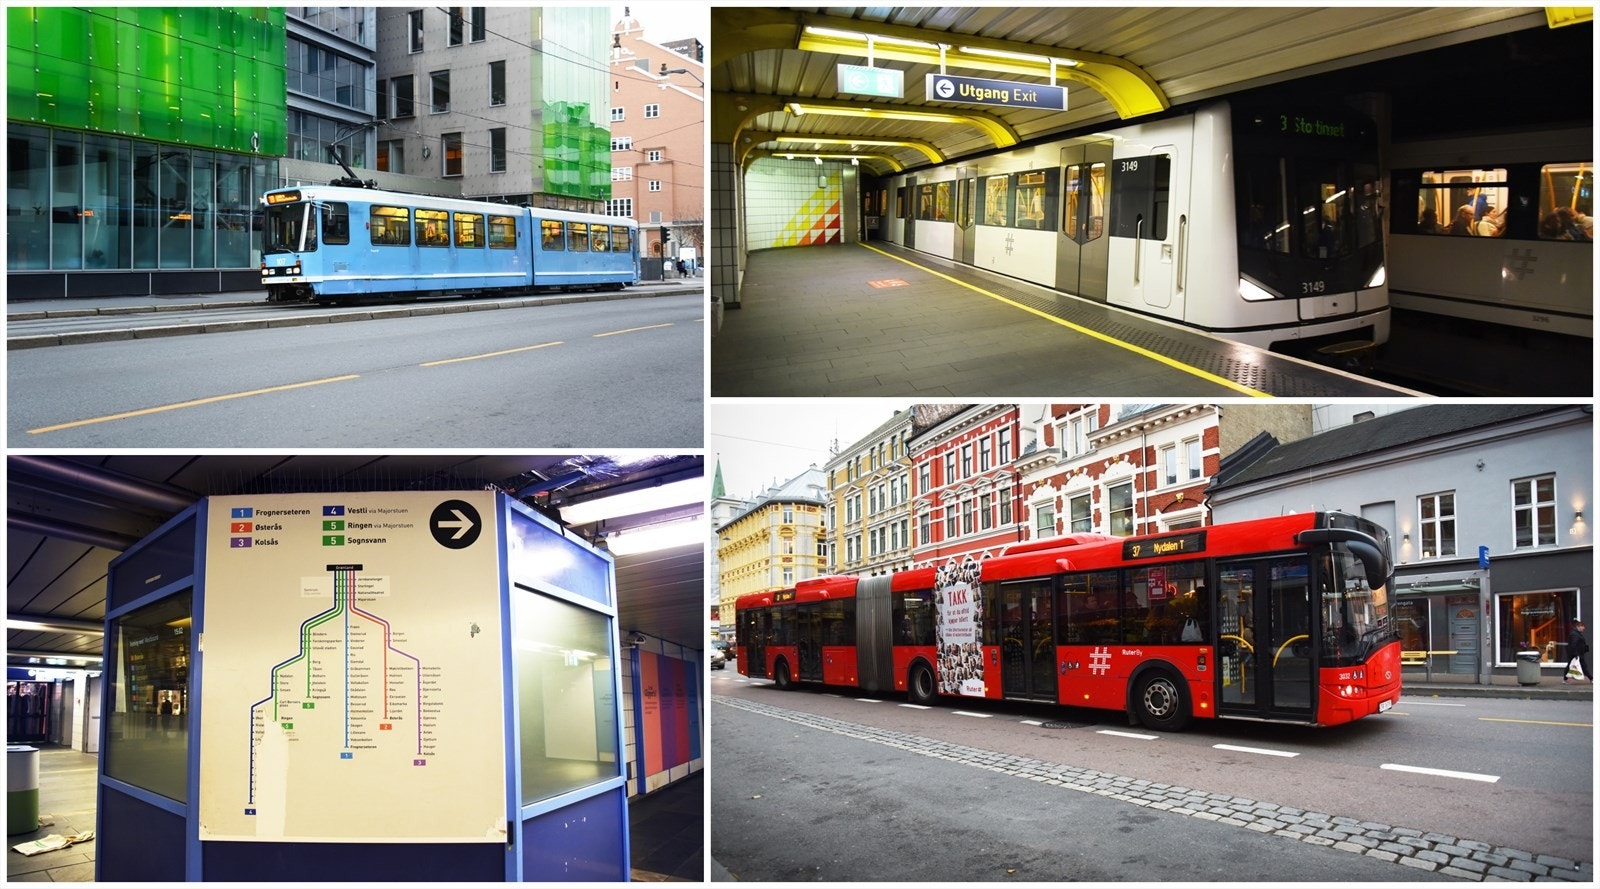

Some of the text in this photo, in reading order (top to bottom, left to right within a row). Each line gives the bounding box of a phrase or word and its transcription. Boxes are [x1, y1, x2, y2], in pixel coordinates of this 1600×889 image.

[960, 84, 1037, 103] Utgang Exit
[1280, 115, 1287, 131] 3
[1121, 160, 1138, 172] 3149
[1302, 280, 1325, 294] 3149
[240, 509, 311, 517] 1 Frognerseteren
[330, 507, 337, 515] 4
[239, 523, 282, 532] 2 Østerås
[330, 522, 337, 530] 5
[347, 522, 373, 530] Ringen
[238, 538, 279, 547] 3 Kolsås
[330, 537, 387, 545] 5 Sognsvann
[1132, 539, 1185, 557] 37 Nydalen T
[948, 589, 967, 606] TAKK
